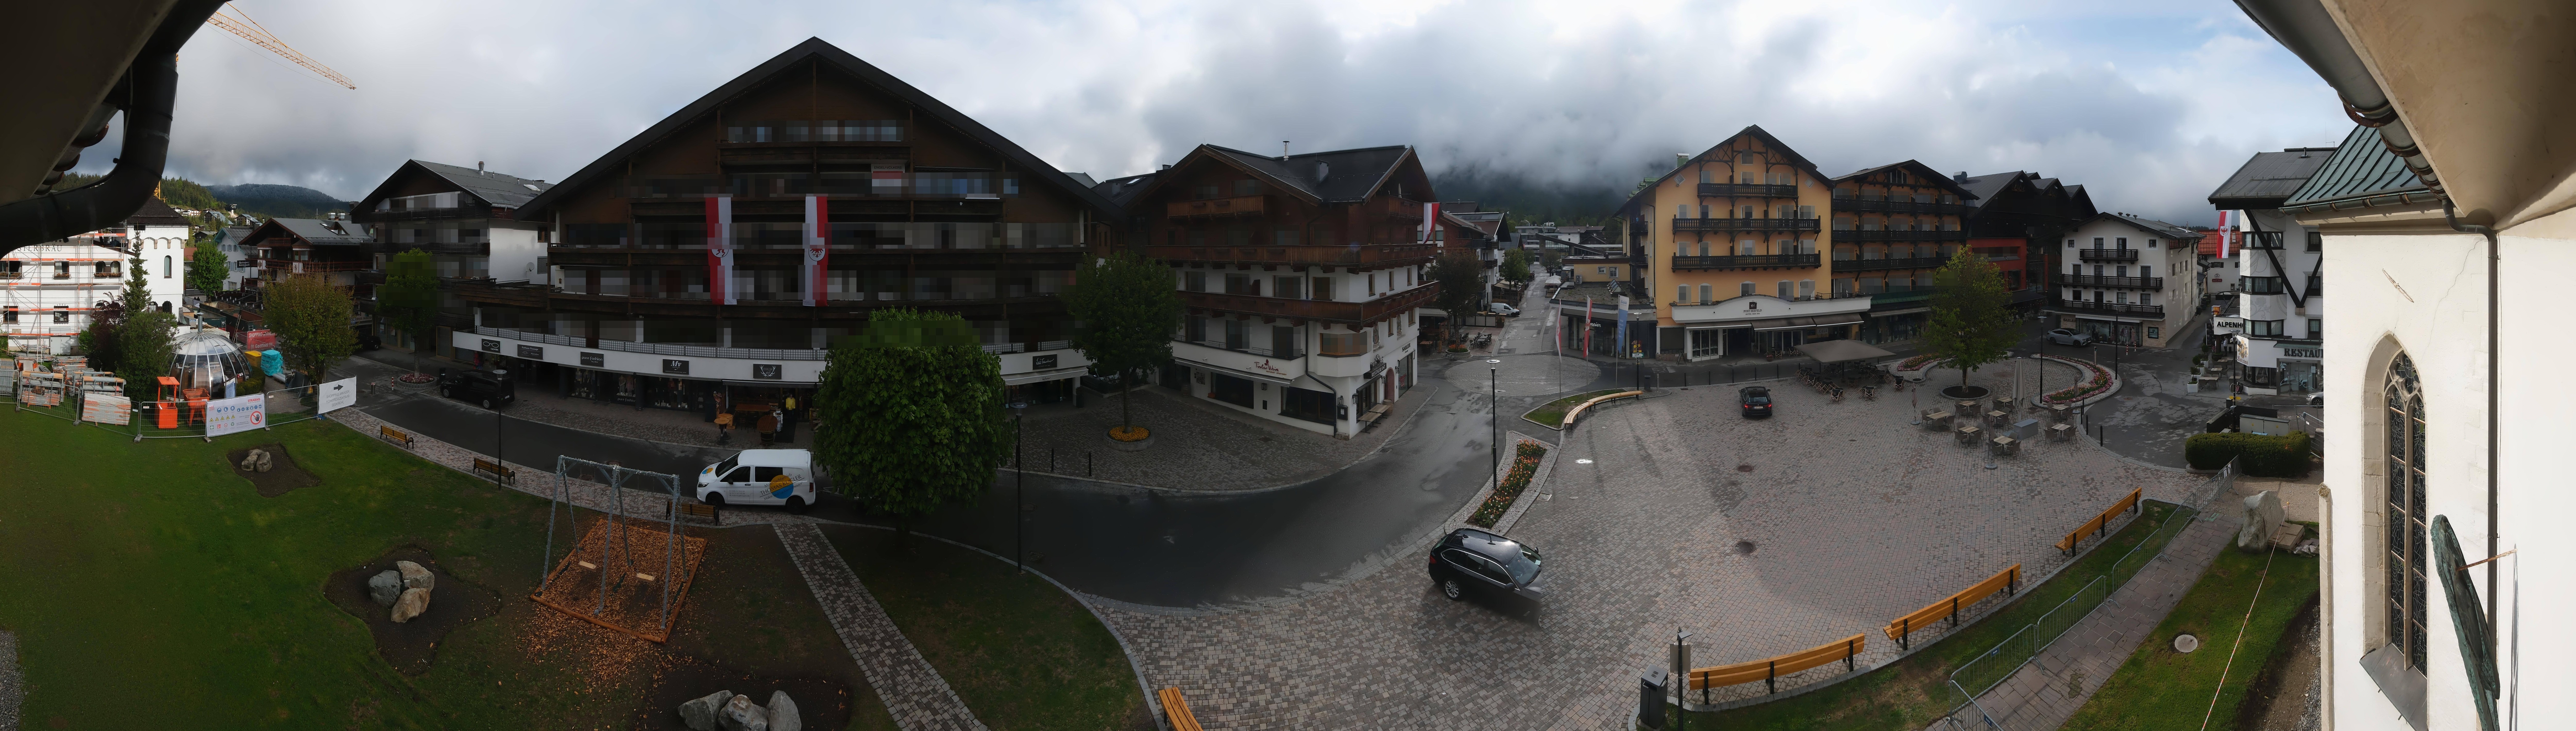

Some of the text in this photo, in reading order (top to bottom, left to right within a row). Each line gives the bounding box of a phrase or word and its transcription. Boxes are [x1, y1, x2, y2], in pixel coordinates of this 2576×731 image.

[1402, 343, 1411, 352] SAILER
[671, 361, 682, 370] My
[1371, 364, 1386, 377] RESTAURANT
[326, 394, 350, 403] KONGRESSZENTRUM
[760, 474, 802, 495] THOMAS KUGLER
[764, 473, 792, 488] Malerfachbetrieb
